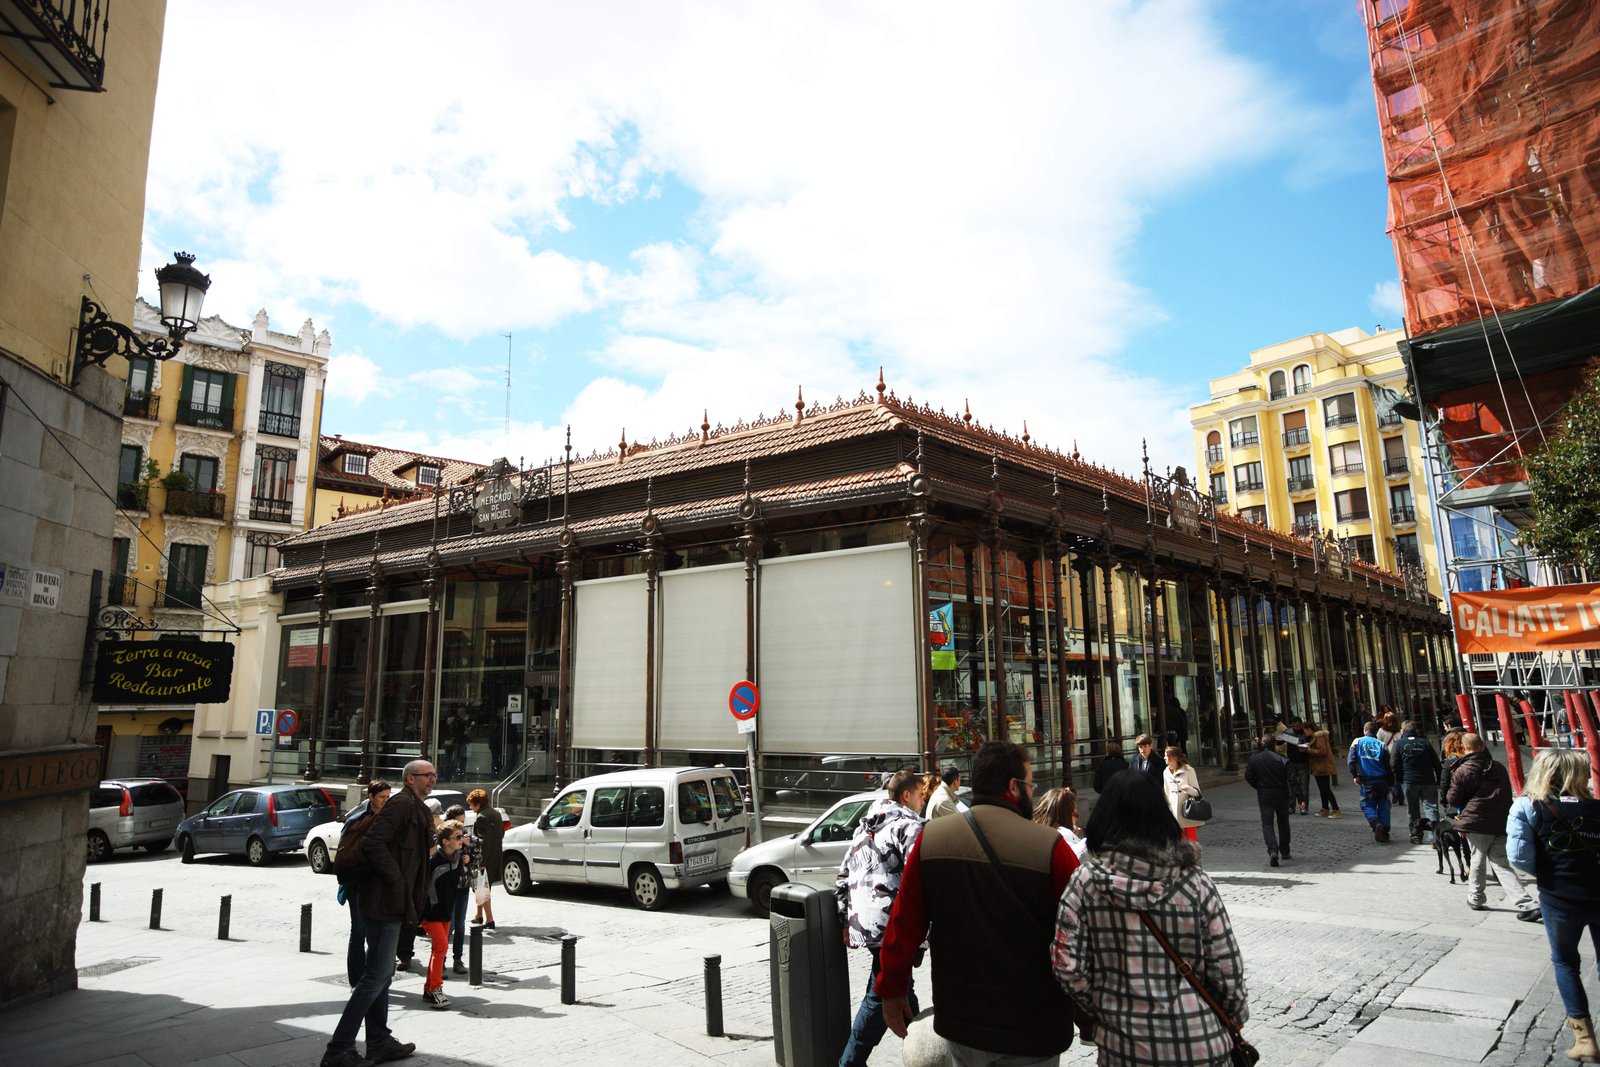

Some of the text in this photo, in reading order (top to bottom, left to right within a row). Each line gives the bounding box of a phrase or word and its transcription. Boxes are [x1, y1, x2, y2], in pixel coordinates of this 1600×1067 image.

[481, 491, 512, 506] MERCADO
[478, 509, 512, 523] SAN MIGUEL
[1458, 603, 1569, 638] CÁLLATE
[163, 648, 173, 658] a
[144, 663, 183, 678] Bar
[108, 672, 214, 696] Restaurante
